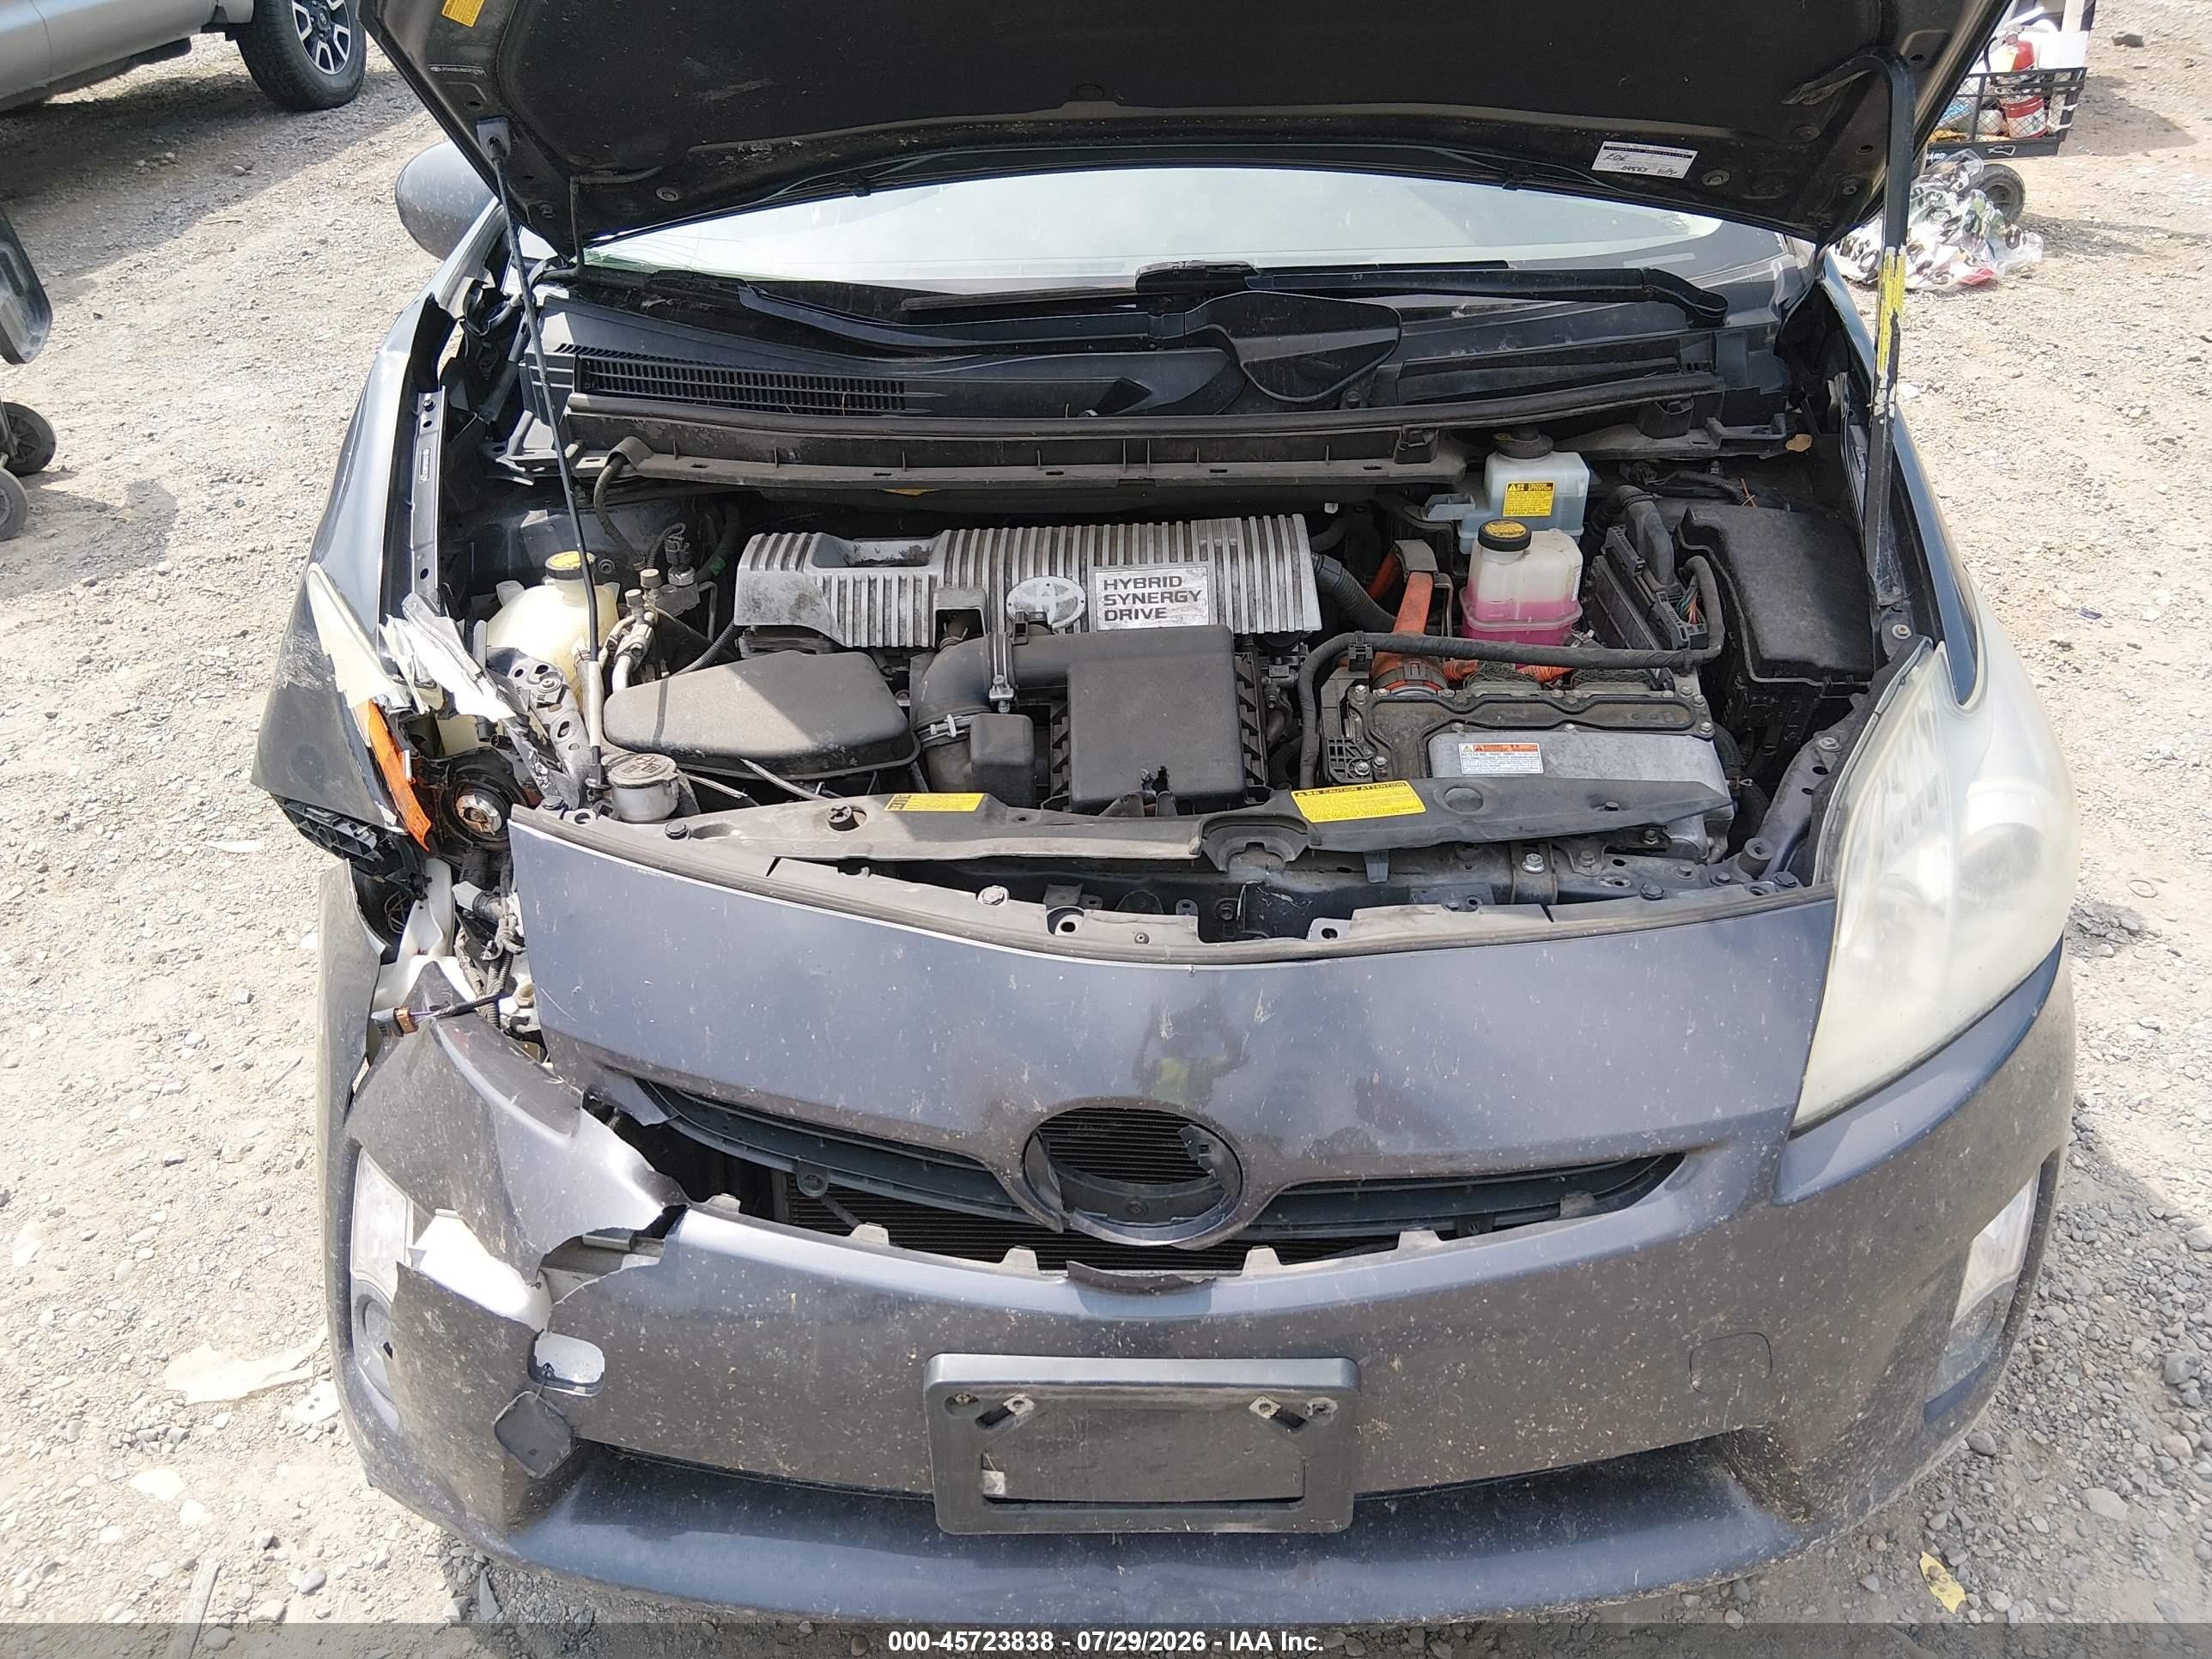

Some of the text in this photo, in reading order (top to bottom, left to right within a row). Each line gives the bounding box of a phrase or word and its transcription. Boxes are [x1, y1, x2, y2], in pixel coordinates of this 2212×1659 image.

[1103, 575, 1183, 591] HYBRID
[1103, 589, 1203, 606] SYNERGY
[1104, 607, 1168, 622] DRIVE
[1322, 781, 1407, 795] CAUTION ATTENTION
